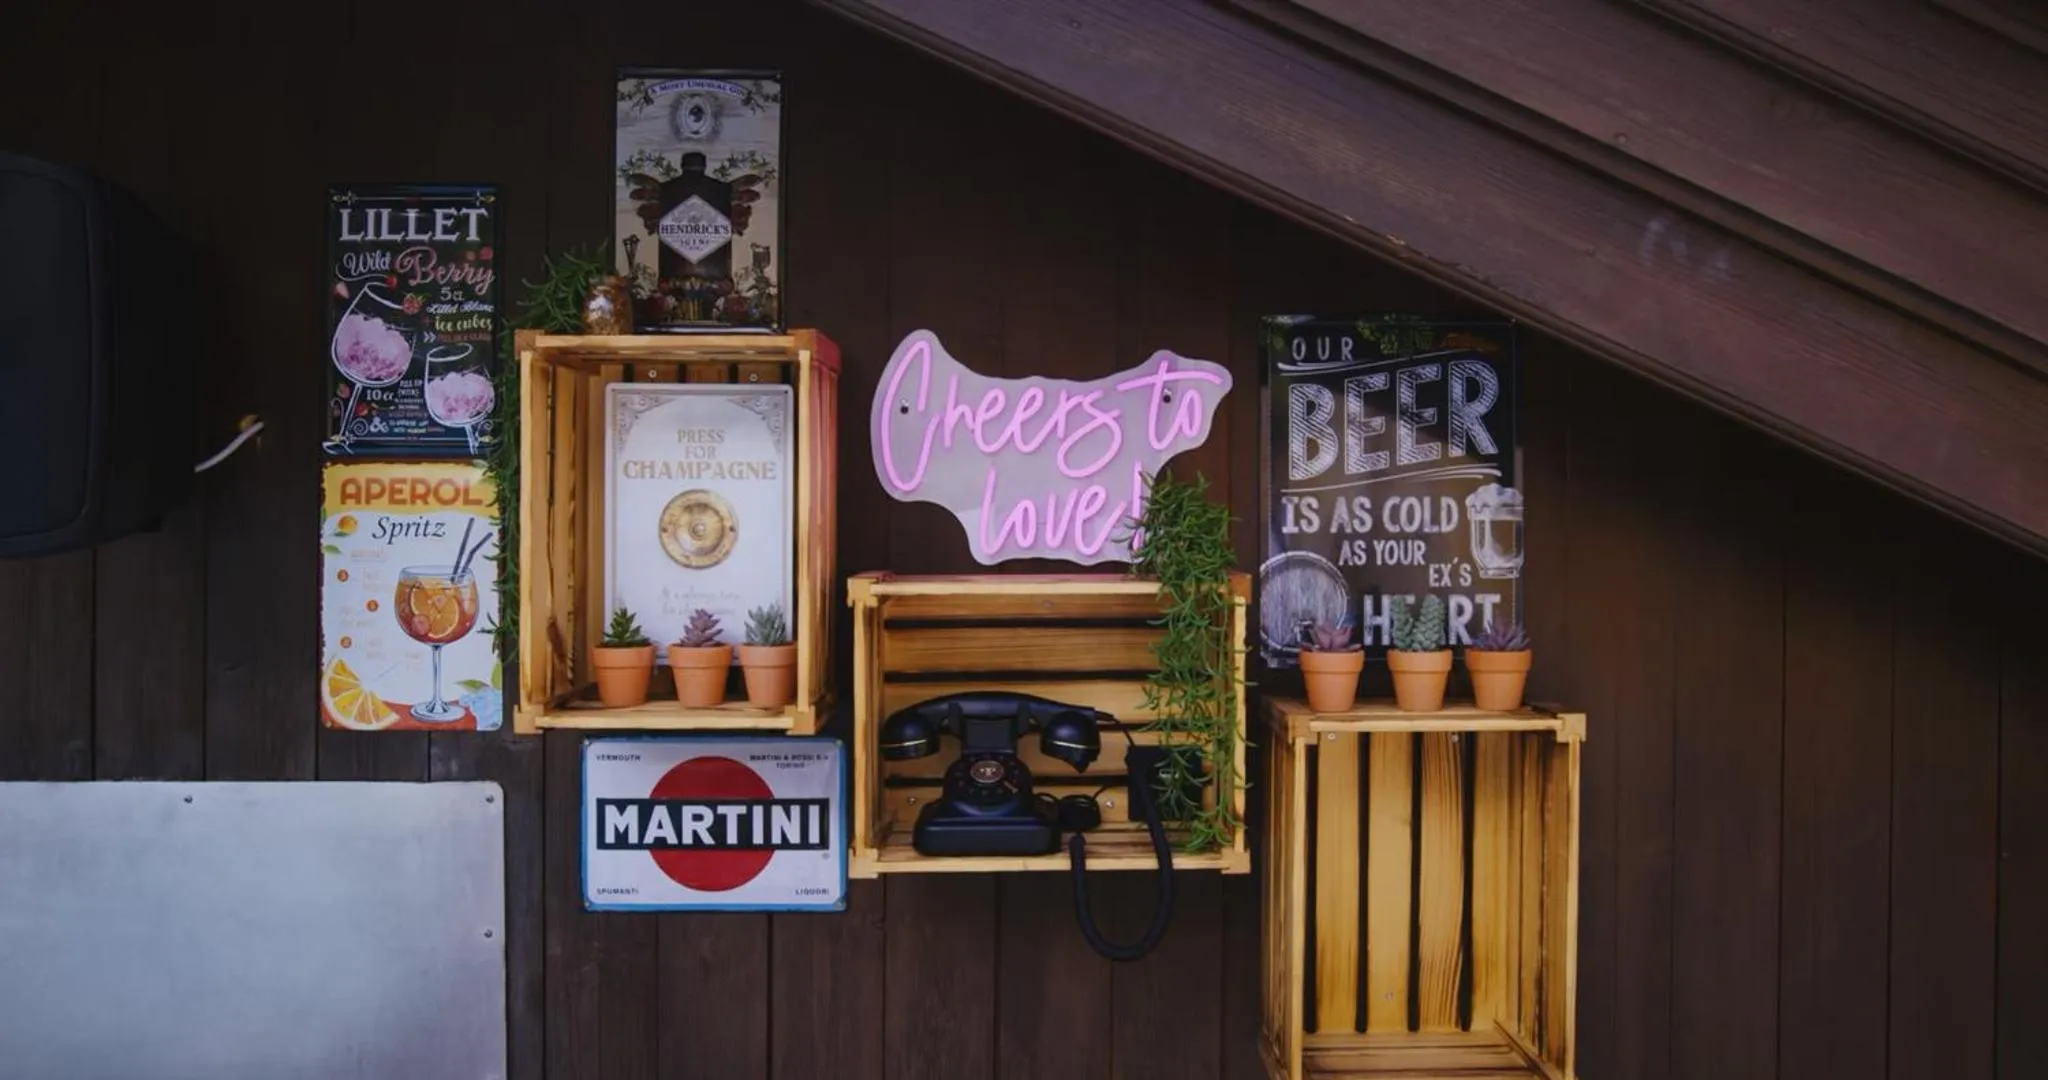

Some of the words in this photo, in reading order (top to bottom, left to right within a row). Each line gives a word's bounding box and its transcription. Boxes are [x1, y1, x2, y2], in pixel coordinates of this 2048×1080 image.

[338, 207, 489, 242] LILLET
[660, 223, 730, 235] HENDRICK'S
[336, 250, 391, 279] Wild
[394, 246, 495, 296] Berry
[434, 315, 453, 332] ice
[456, 313, 493, 332] cubes
[1291, 336, 1354, 361] OUR
[881, 340, 1122, 492] Cheers
[1116, 360, 1222, 451] to
[1288, 360, 1500, 481] BEER
[677, 429, 726, 444] PRESS
[684, 445, 717, 460] FOR
[622, 460, 777, 480] CHAMPAGNE
[339, 477, 484, 506] APEROL
[1281, 496, 1321, 534] IS
[1330, 496, 1373, 534] AS
[1382, 496, 1459, 534] COLD
[371, 515, 447, 546] Spritz
[1338, 540, 1367, 566] AS
[1373, 540, 1427, 566] YOUR
[1428, 556, 1472, 588] EX'S
[1363, 593, 1501, 646] HRT
[596, 754, 641, 762] VERMOUTH
[603, 804, 820, 845] MARTINI
[795, 887, 829, 896] LIQUORI
